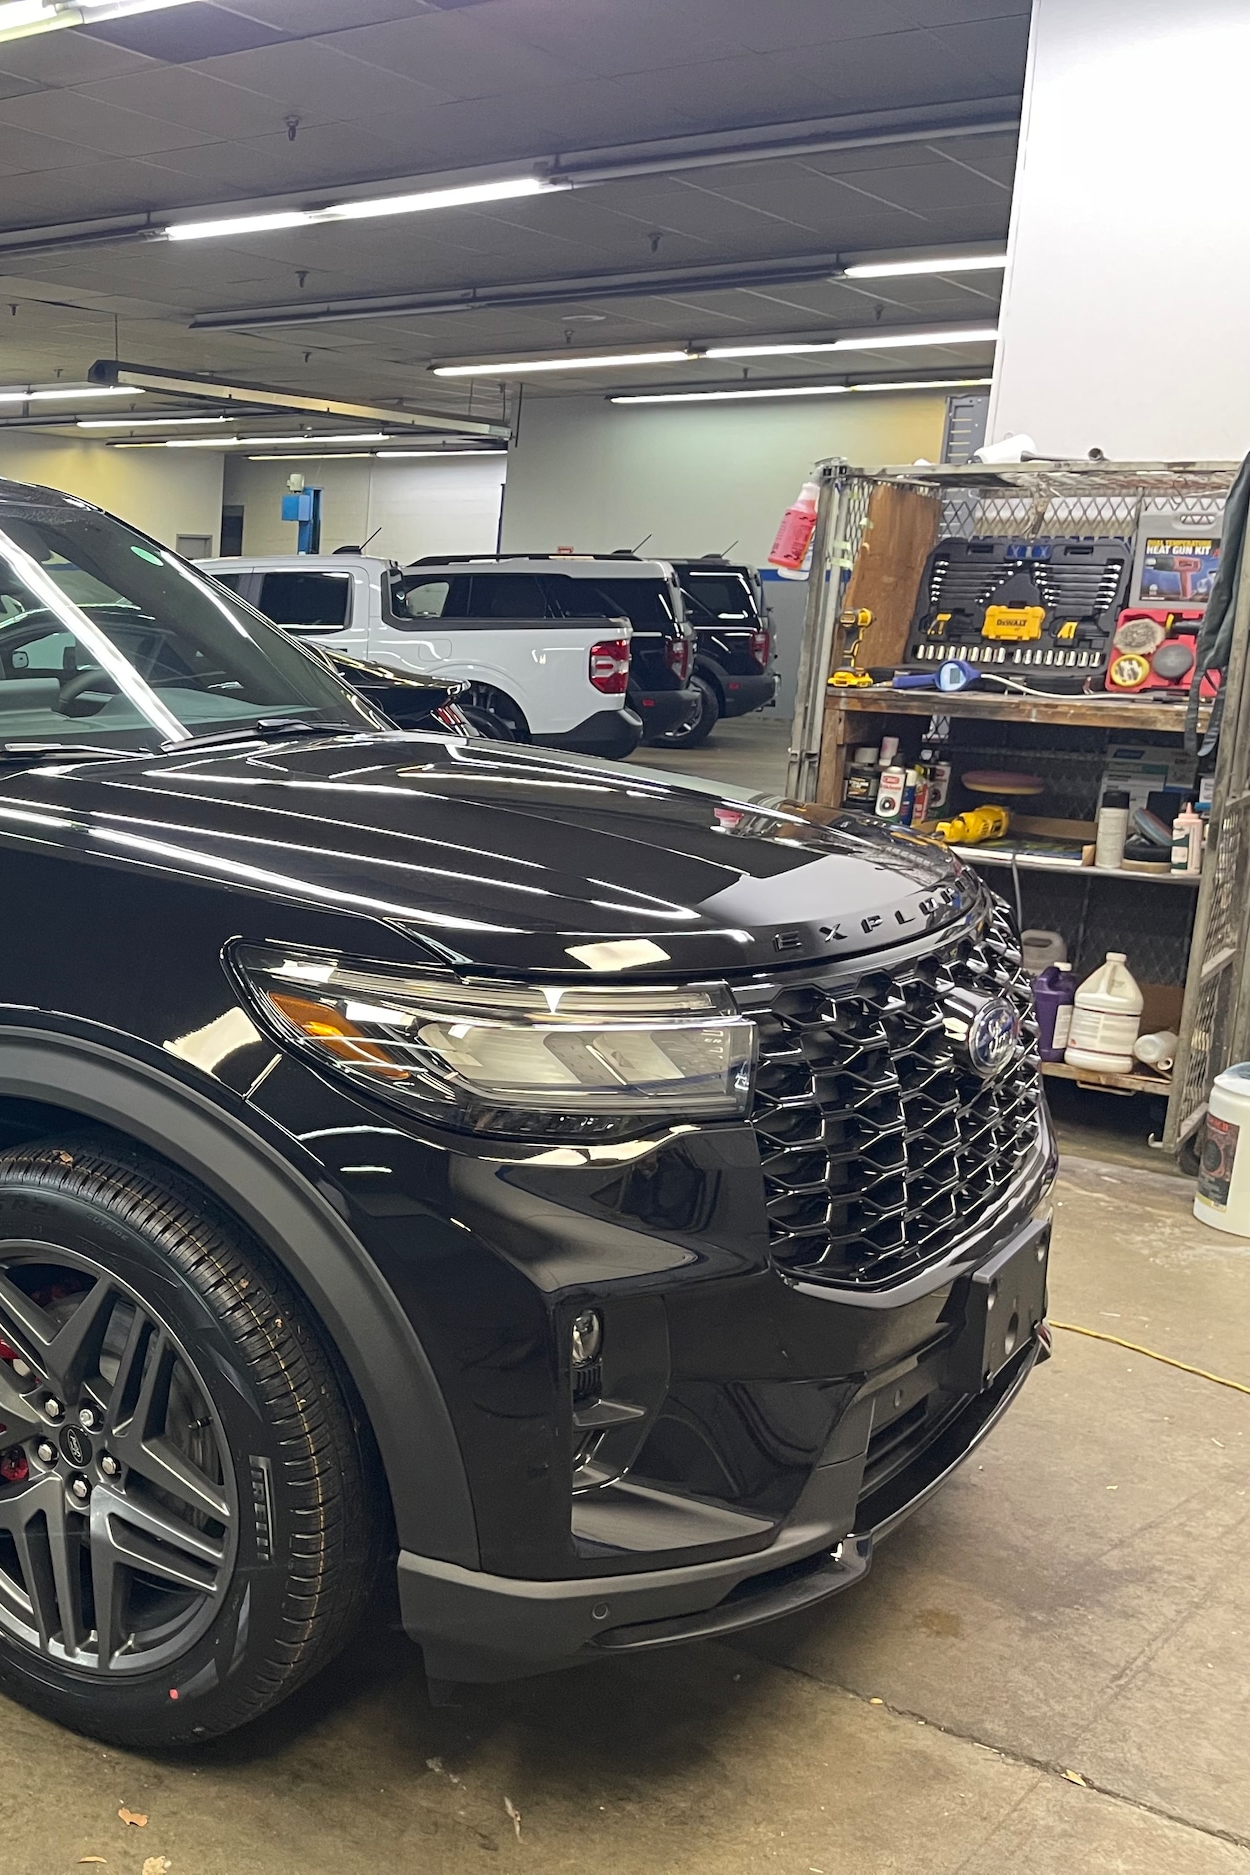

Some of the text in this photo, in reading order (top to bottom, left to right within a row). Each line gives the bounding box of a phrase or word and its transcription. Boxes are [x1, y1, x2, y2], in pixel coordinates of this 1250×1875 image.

[1146, 545, 1212, 555] HEAT GUN KIT
[78, 1213, 130, 1241] OUTSIDE
